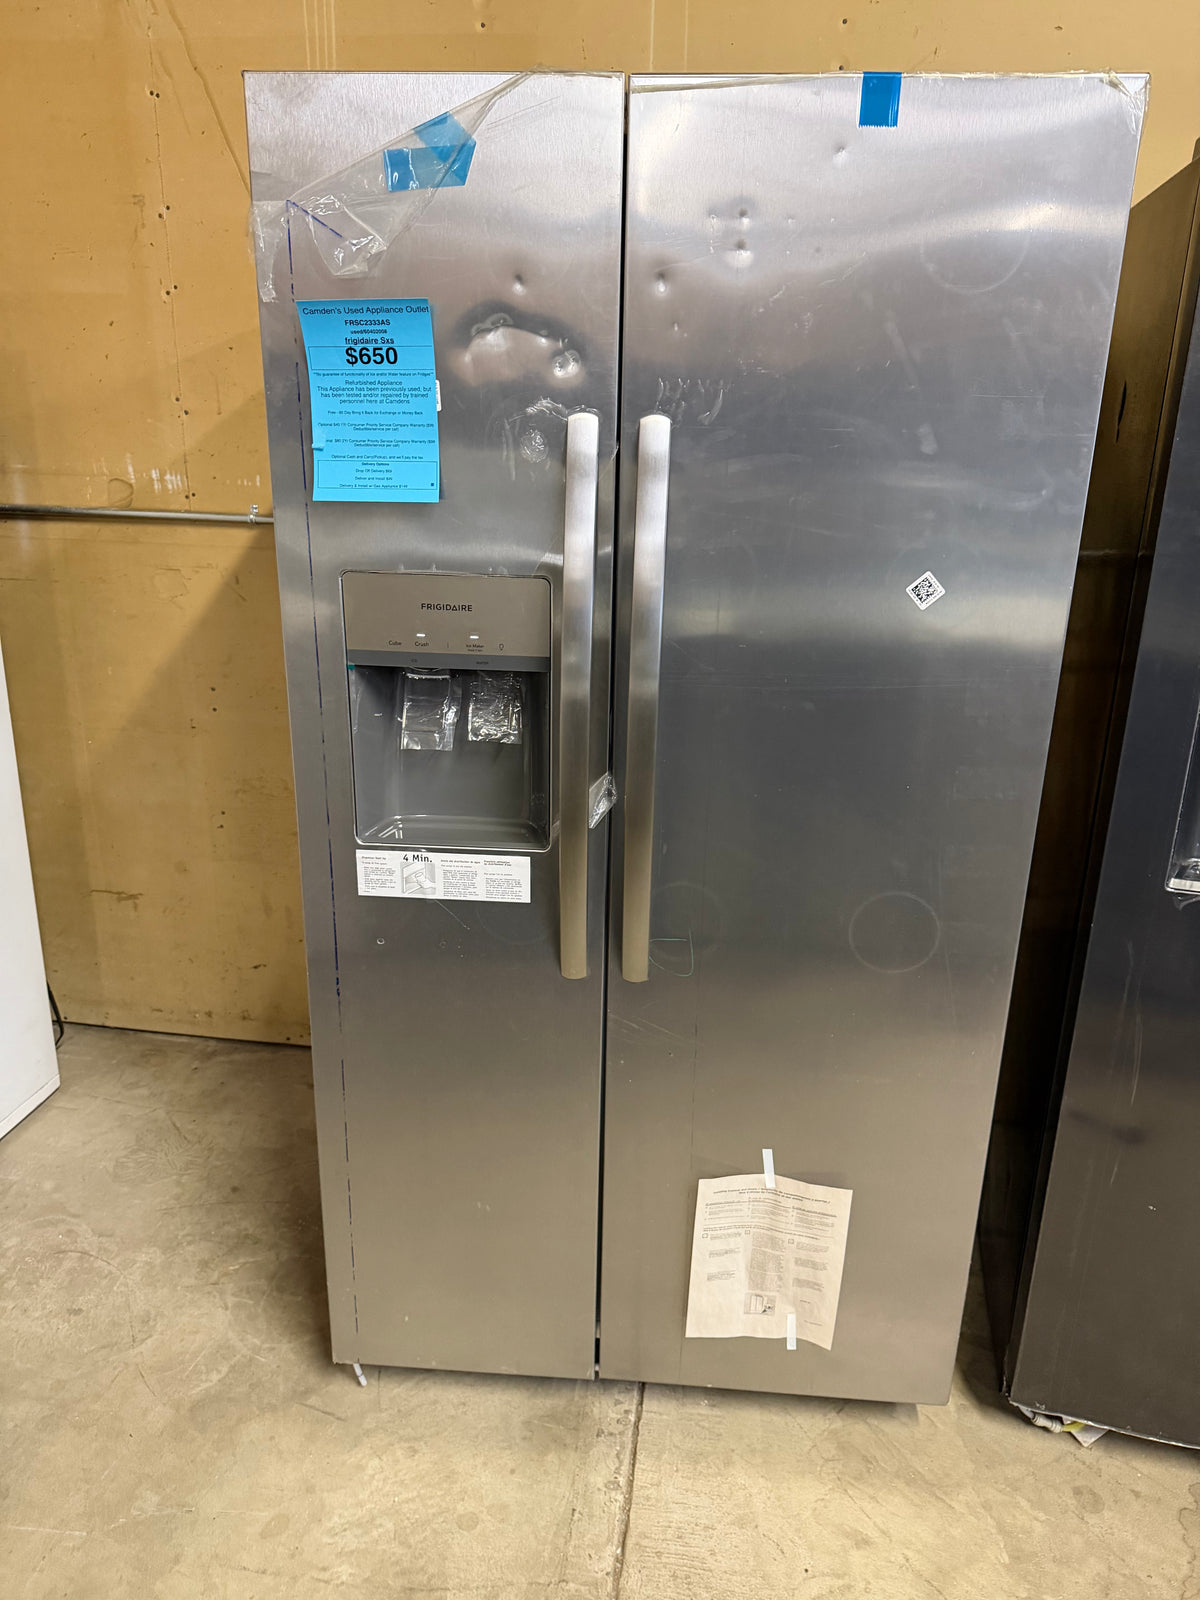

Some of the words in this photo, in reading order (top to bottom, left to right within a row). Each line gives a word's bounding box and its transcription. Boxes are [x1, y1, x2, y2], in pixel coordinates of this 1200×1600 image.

[302, 307, 342, 315] Camden's
[343, 306, 364, 314] Used
[365, 306, 403, 315] Appliance
[405, 305, 429, 313] Outlet
[345, 337, 379, 345] frigidaire
[380, 336, 394, 344] Sxs
[345, 346, 398, 367] $650
[421, 603, 473, 612] FRIGIDAIRE
[402, 853, 409, 862] 4
[412, 854, 433, 863] Min.
